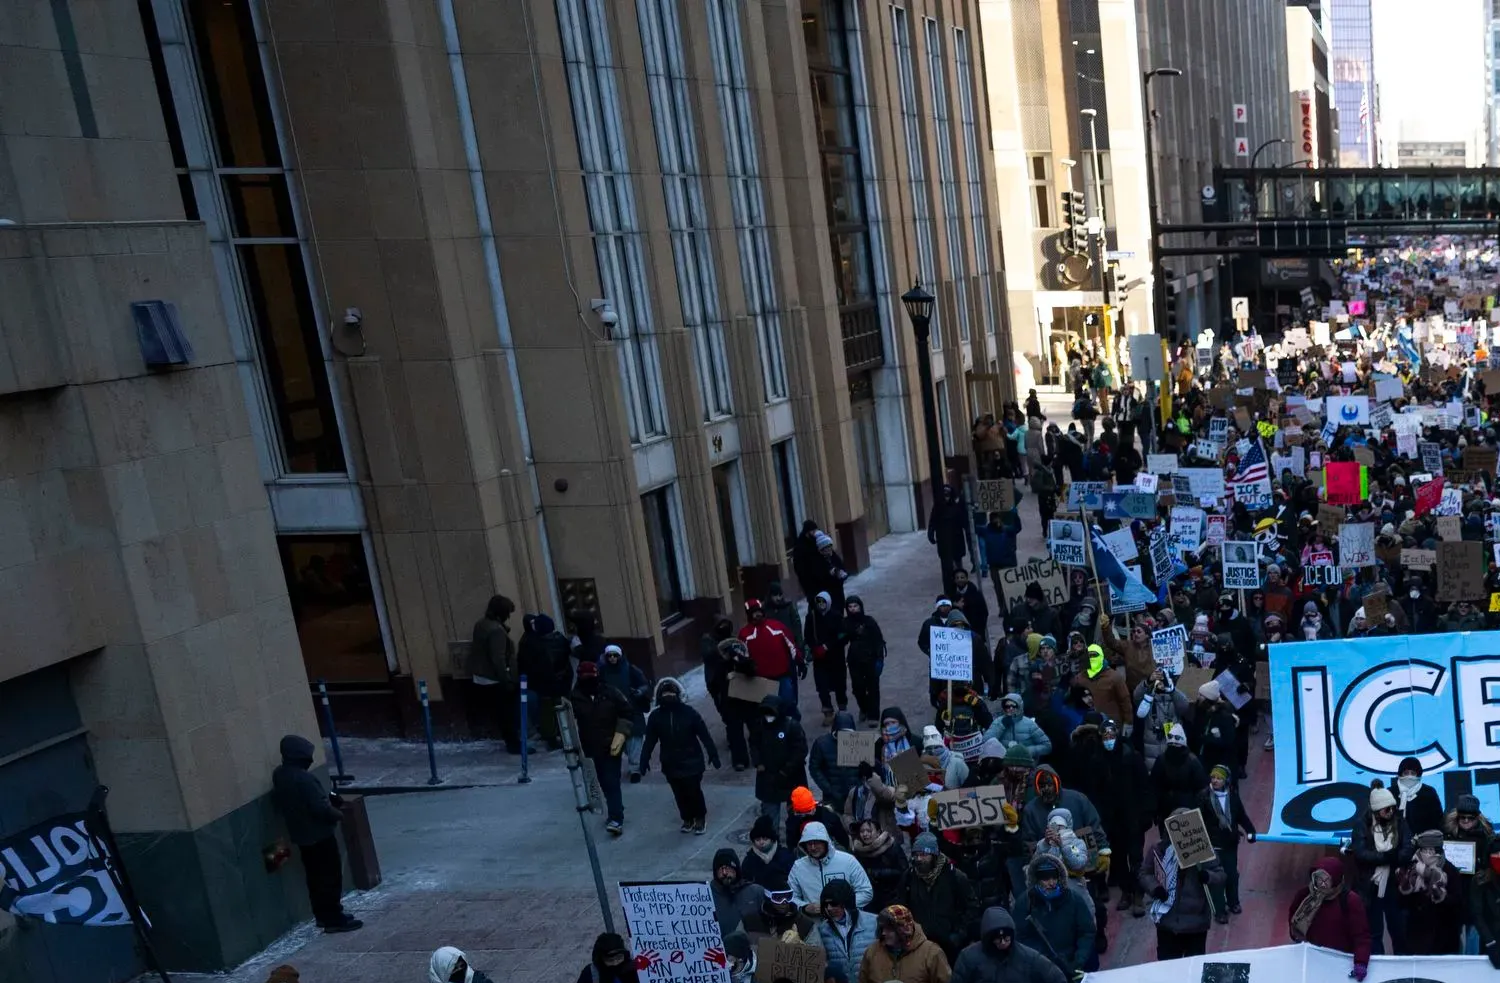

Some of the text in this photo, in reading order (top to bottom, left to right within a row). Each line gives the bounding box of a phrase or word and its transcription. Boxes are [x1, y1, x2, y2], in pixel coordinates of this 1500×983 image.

[1301, 104, 1312, 153] WCCO
[1212, 420, 1227, 431] STOP
[1237, 484, 1259, 495] ICE
[1259, 494, 1271, 504] OF
[1054, 544, 1082, 554] JUSTICE
[1343, 552, 1370, 564] WINS
[1004, 560, 1063, 584] CHINGA
[1225, 567, 1257, 579] JUSTICE
[1304, 564, 1322, 586] ICE
[933, 630, 964, 641] WE DO
[935, 643, 949, 652] NOT
[936, 654, 969, 664] NEGOTIATE
[934, 669, 970, 679] TERRORISTS
[937, 796, 1007, 829] RESIST
[622, 888, 712, 904] Protesters Arrested
[633, 902, 646, 918] By
[634, 936, 722, 954] Arrested By MPD
[774, 945, 820, 965] NAZ
[646, 958, 718, 978] MN WILL
